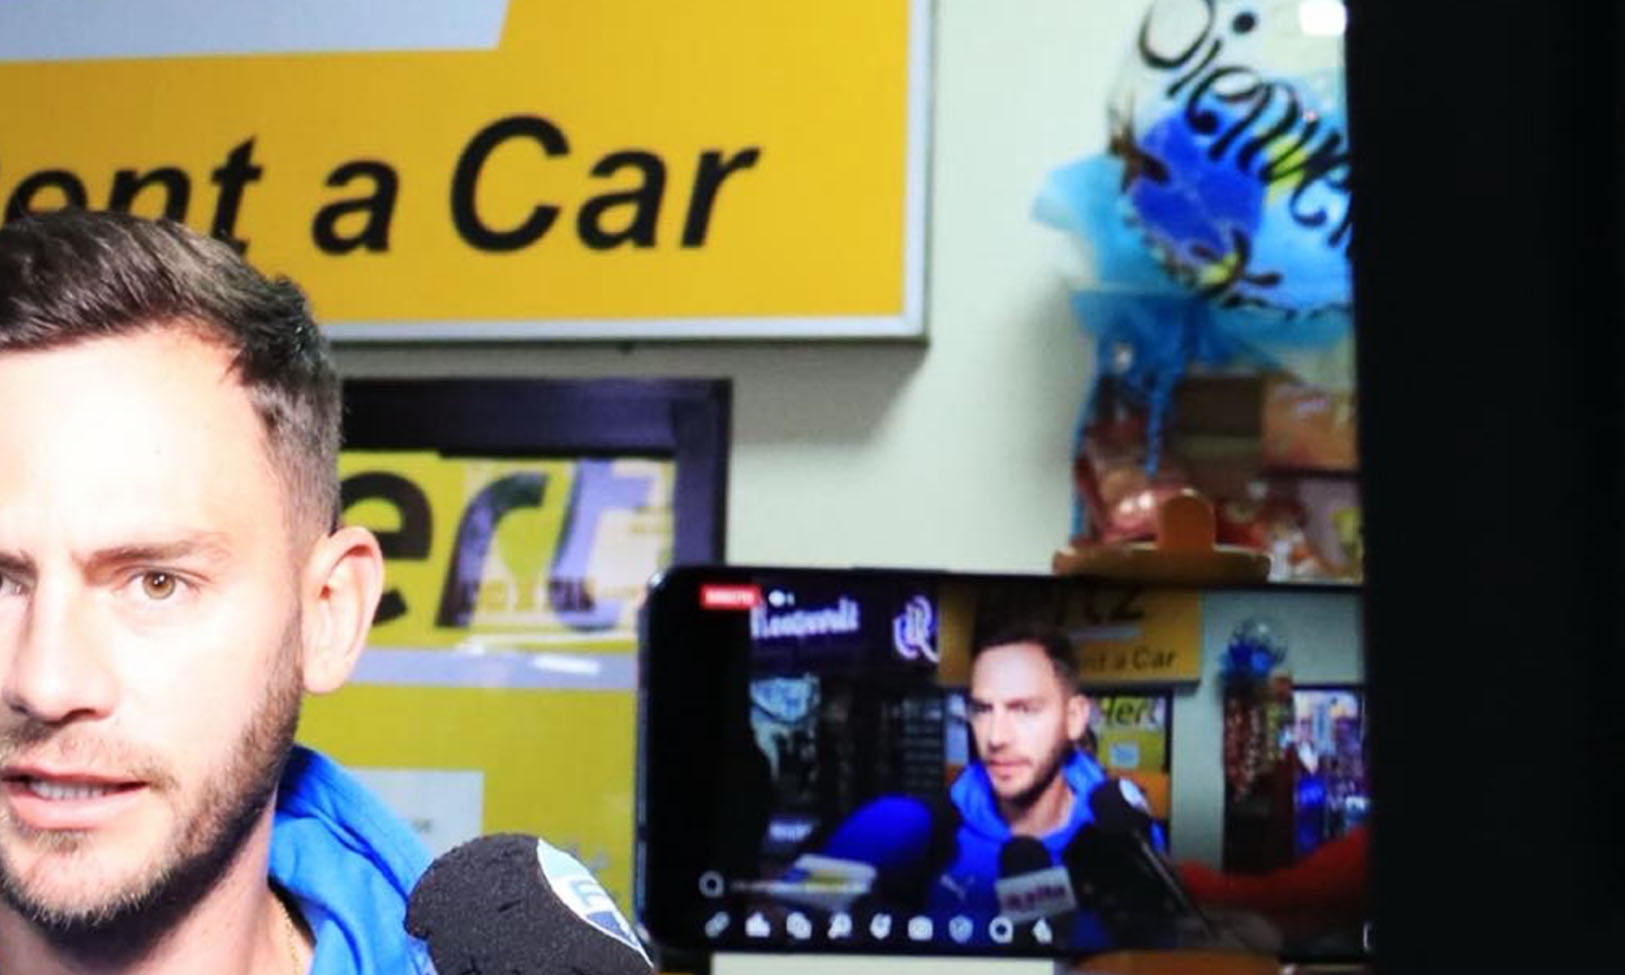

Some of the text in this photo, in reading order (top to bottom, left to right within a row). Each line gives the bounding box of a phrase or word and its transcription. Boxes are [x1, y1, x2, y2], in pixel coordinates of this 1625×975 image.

[312, 158, 400, 254] a
[449, 114, 761, 253] Car
[341, 458, 656, 632] ert
